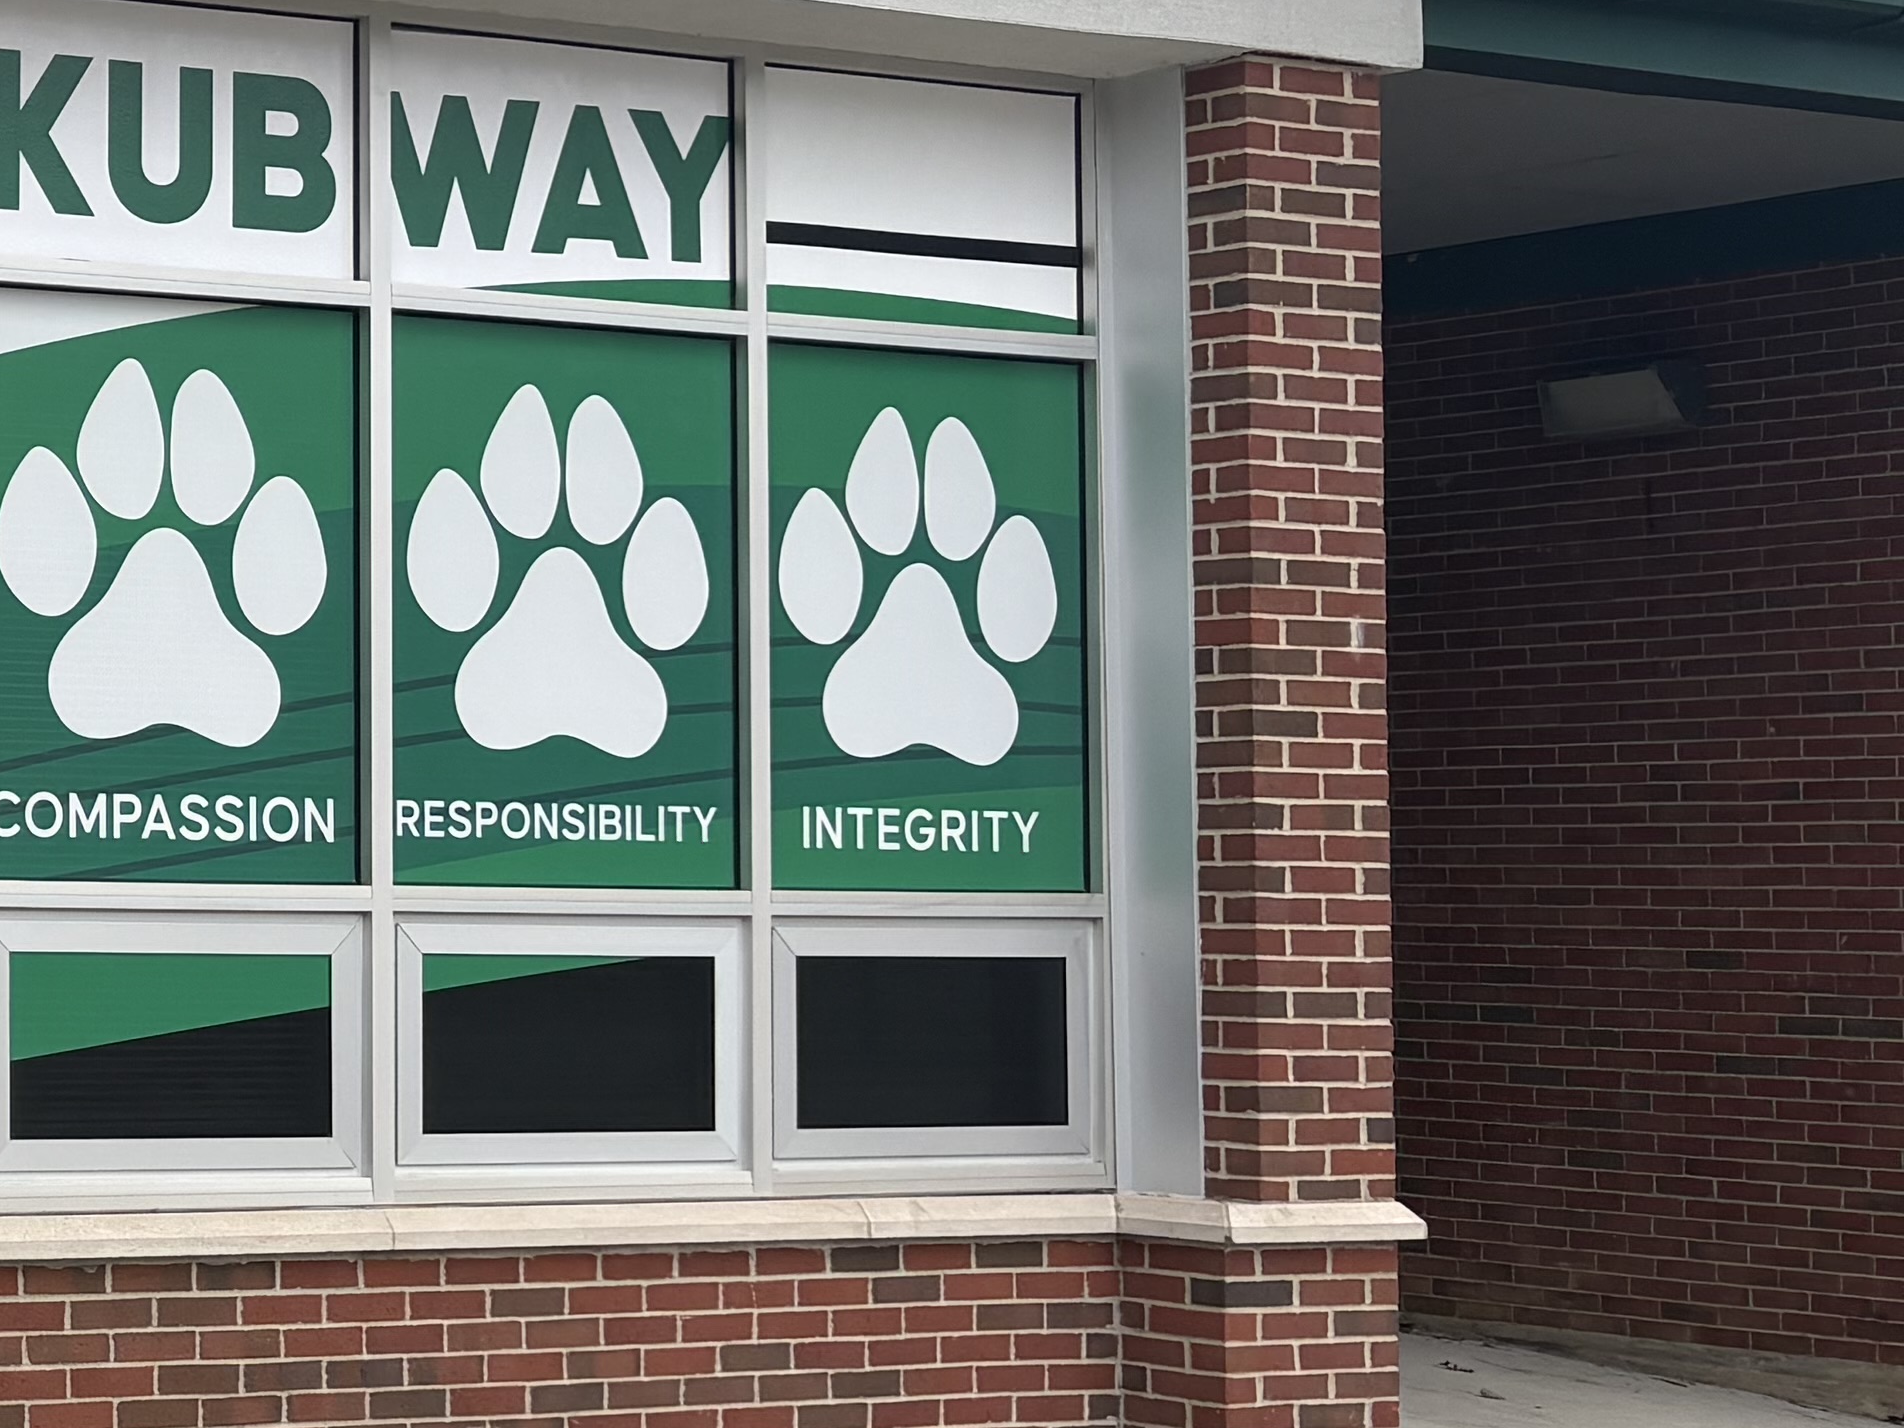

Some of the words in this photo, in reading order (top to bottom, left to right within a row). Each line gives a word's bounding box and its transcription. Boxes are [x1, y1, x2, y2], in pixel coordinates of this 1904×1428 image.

[390, 90, 731, 264] WAY
[395, 798, 719, 844] RESPONSIBILITY
[801, 805, 1040, 855] INTEGRITY
